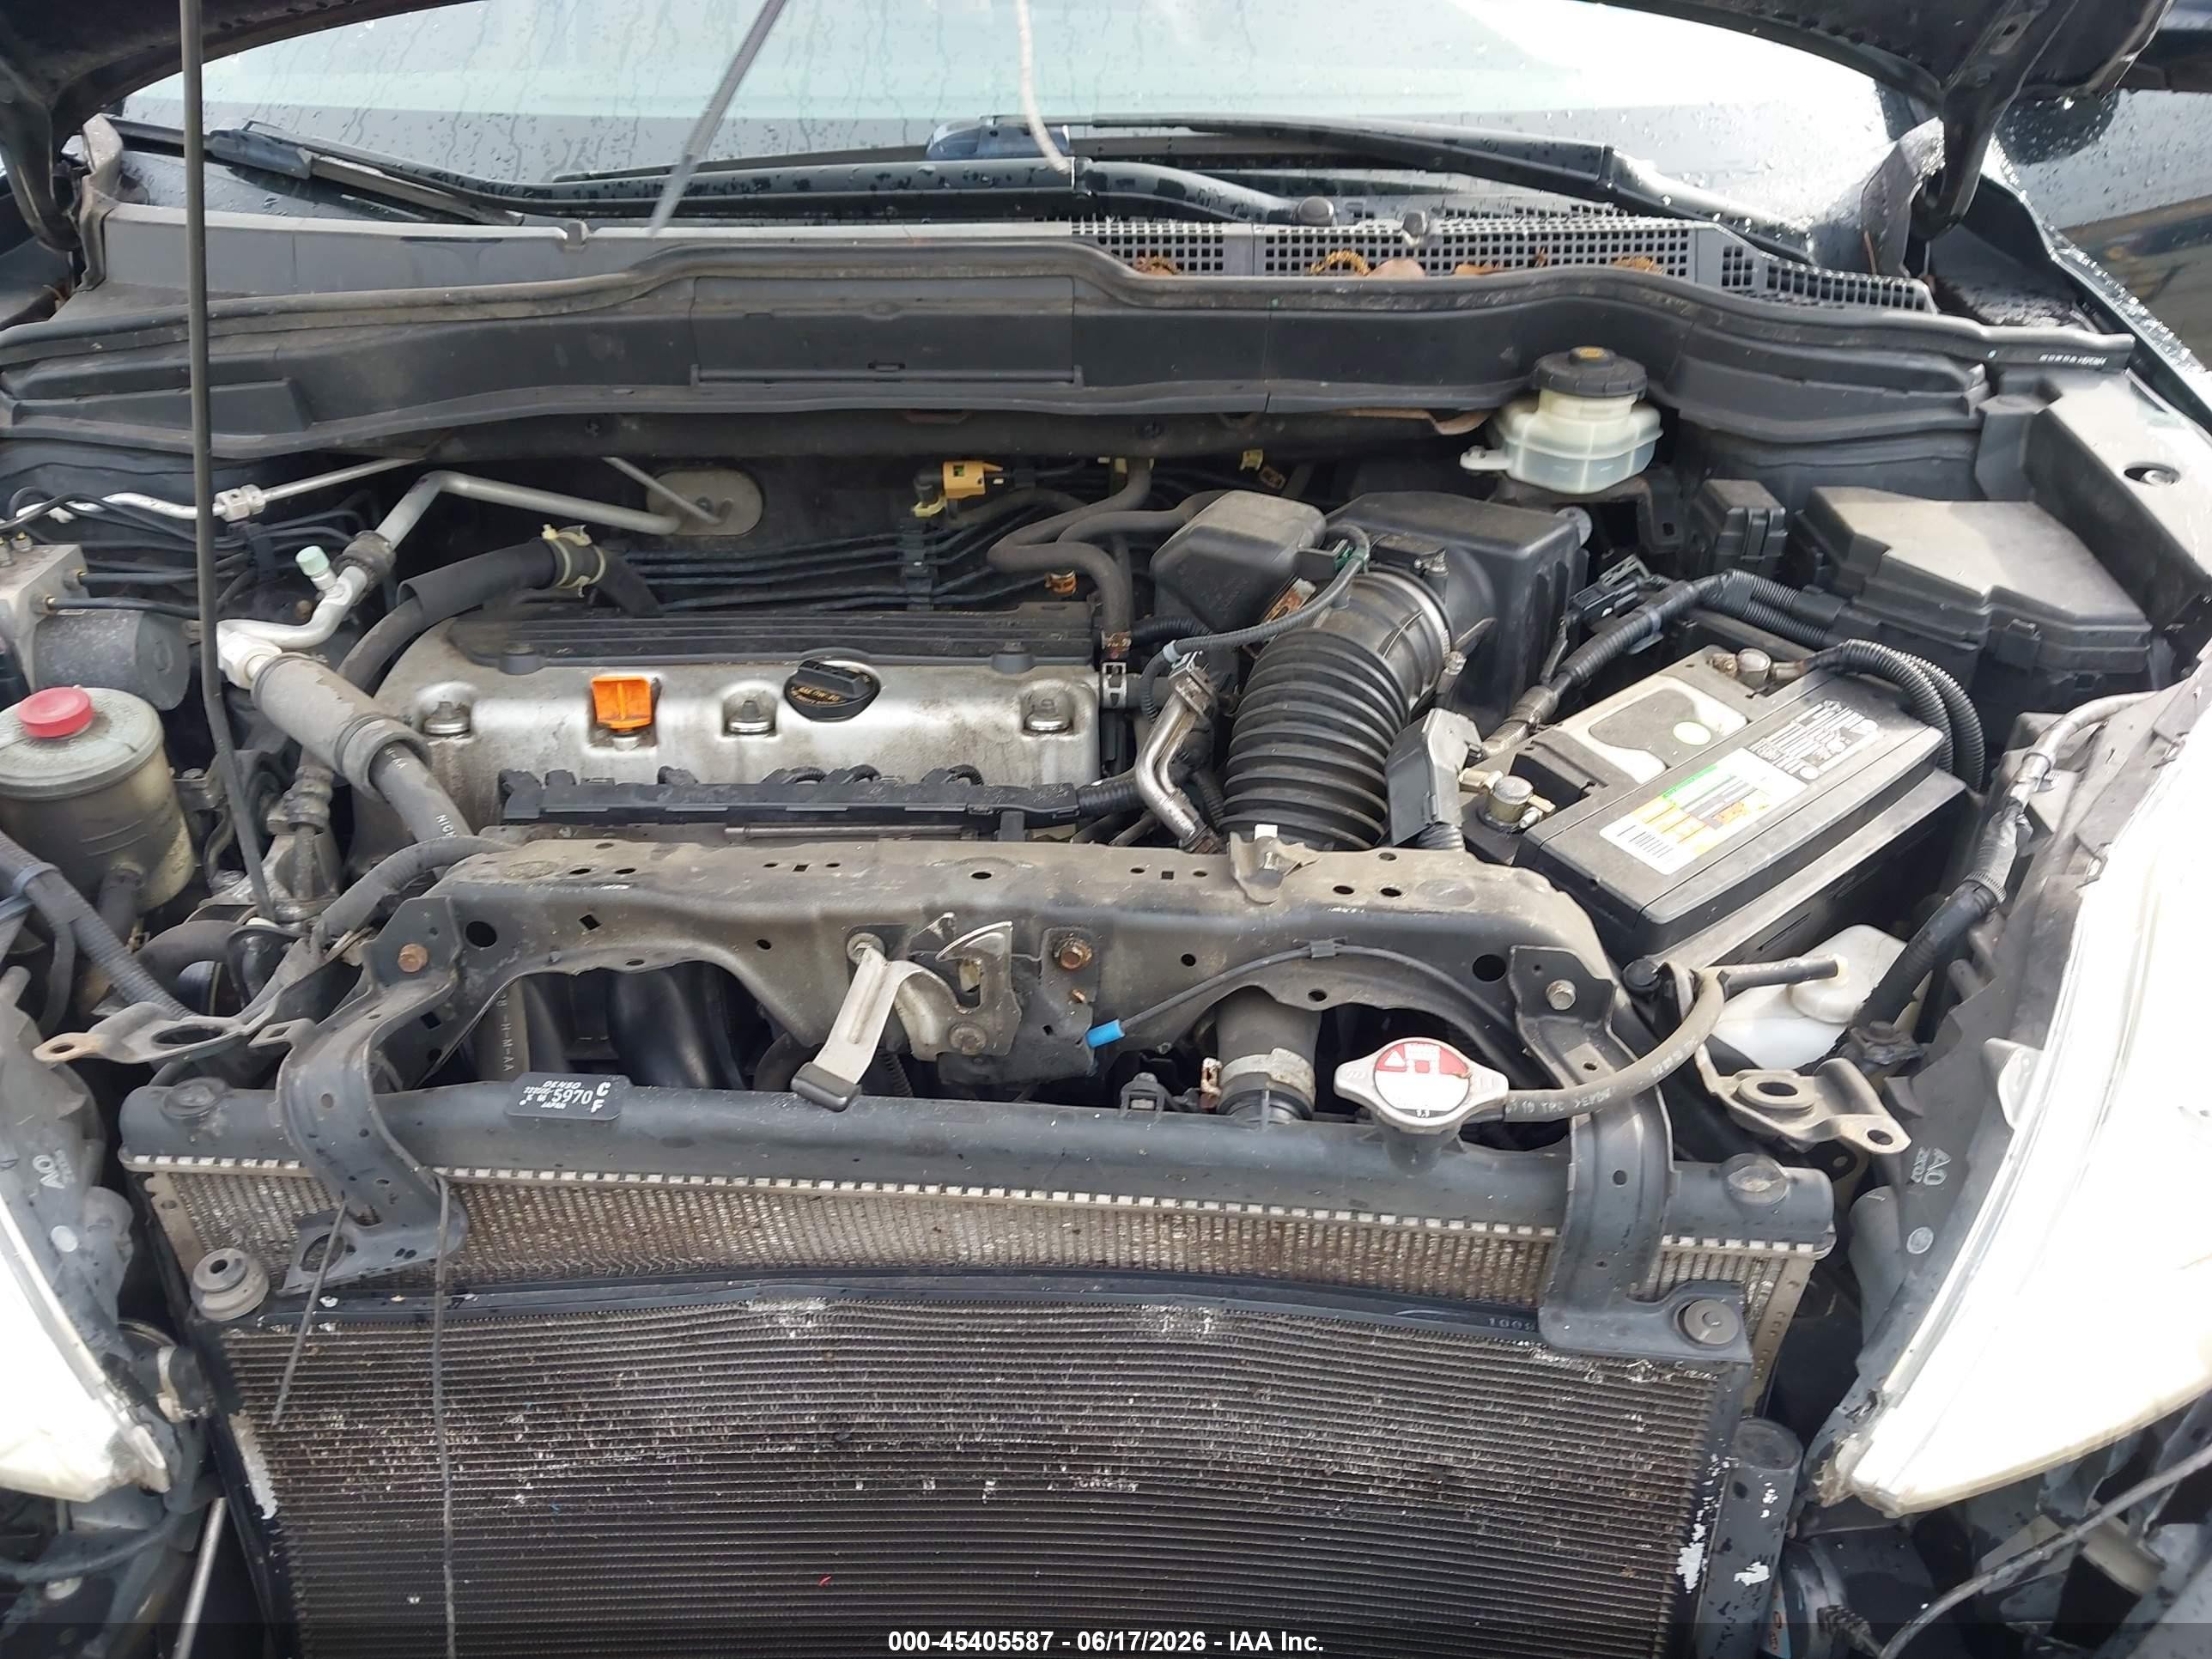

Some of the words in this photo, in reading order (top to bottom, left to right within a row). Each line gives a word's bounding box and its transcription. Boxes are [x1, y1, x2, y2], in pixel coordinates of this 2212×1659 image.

[543, 1080, 582, 1090] DENSO
[596, 1081, 611, 1097] C
[551, 1088, 593, 1105] 5970
[590, 1098, 605, 1113] F
